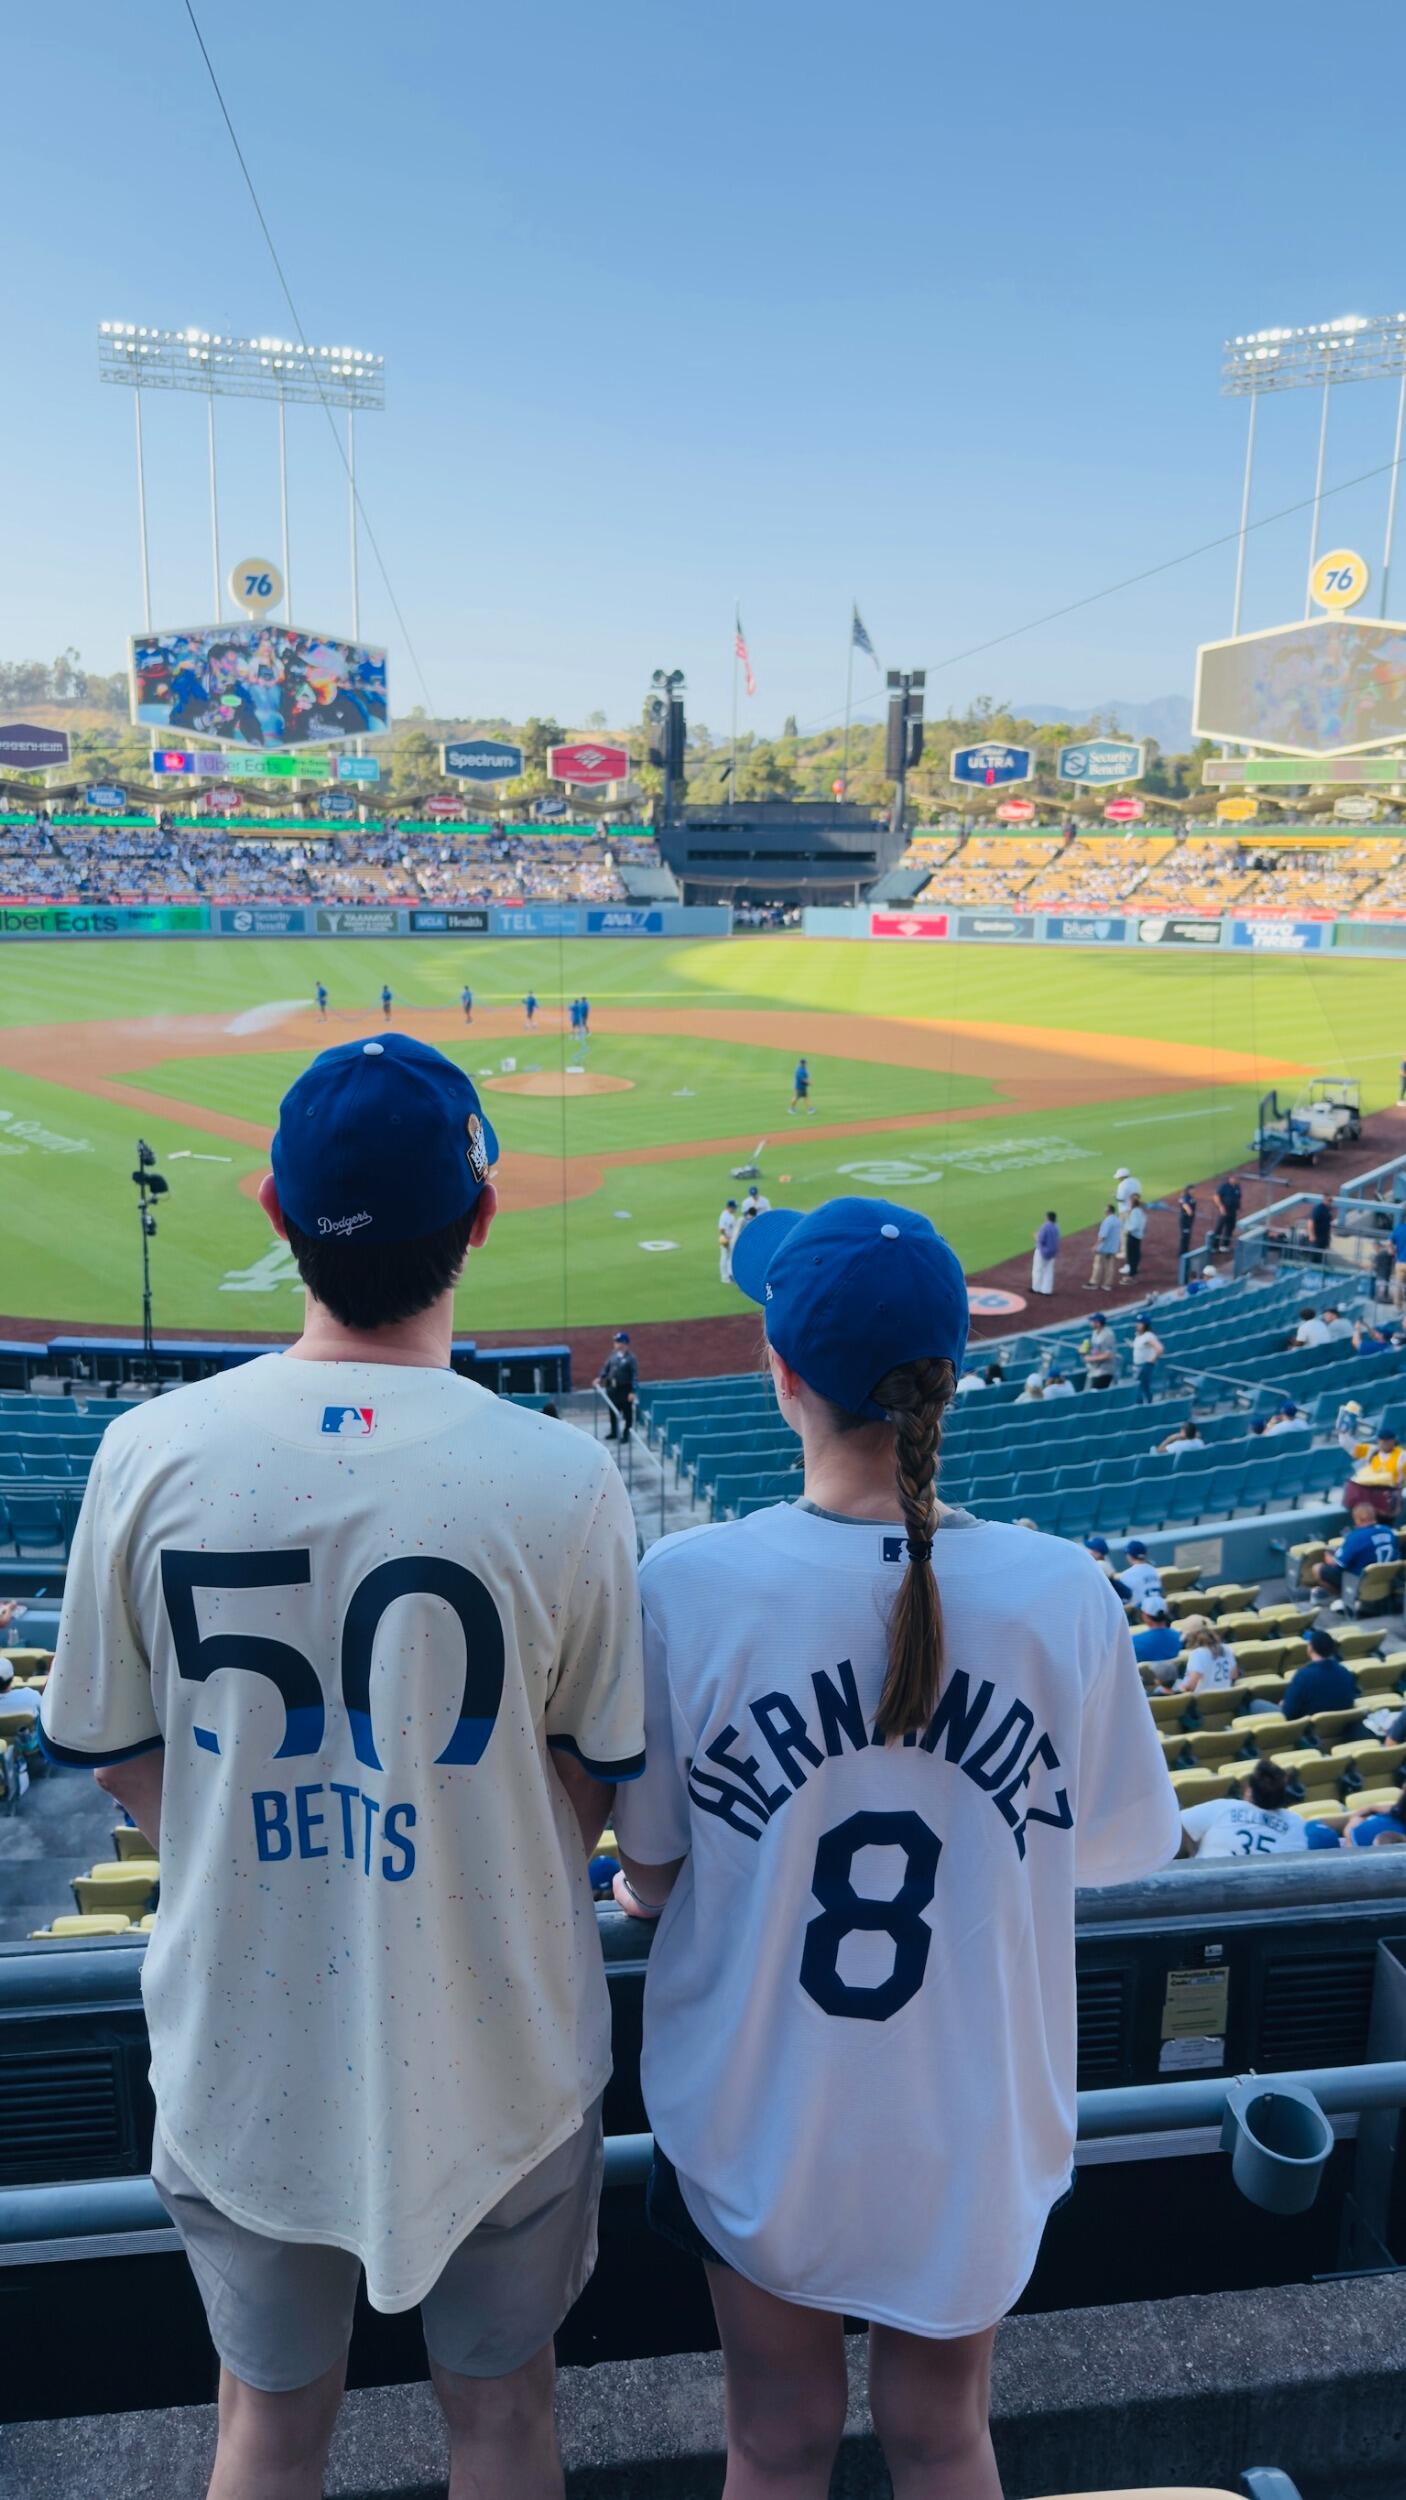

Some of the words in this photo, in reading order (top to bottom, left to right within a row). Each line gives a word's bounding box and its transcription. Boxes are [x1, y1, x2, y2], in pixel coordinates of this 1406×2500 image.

[245, 574, 273, 597] 76
[1325, 568, 1353, 591] 76
[0, 742, 64, 752] GGENHEIM
[203, 757, 241, 772] Uber
[449, 752, 517, 769] Spectrum
[968, 757, 1013, 769] ULTRA
[1089, 751, 1133, 764] Security
[1089, 763, 1128, 776] Benefit
[0, 911, 49, 931] ber
[54, 912, 119, 932] Eats
[501, 914, 535, 930] TEL
[1063, 922, 1093, 935] blue
[317, 1210, 373, 1236] Dodgers
[160, 1548, 506, 1772] 50
[687, 1659, 1074, 1862] HERNNDEZ
[251, 1782, 417, 1882] BETTS
[799, 1810, 943, 2022] 8
